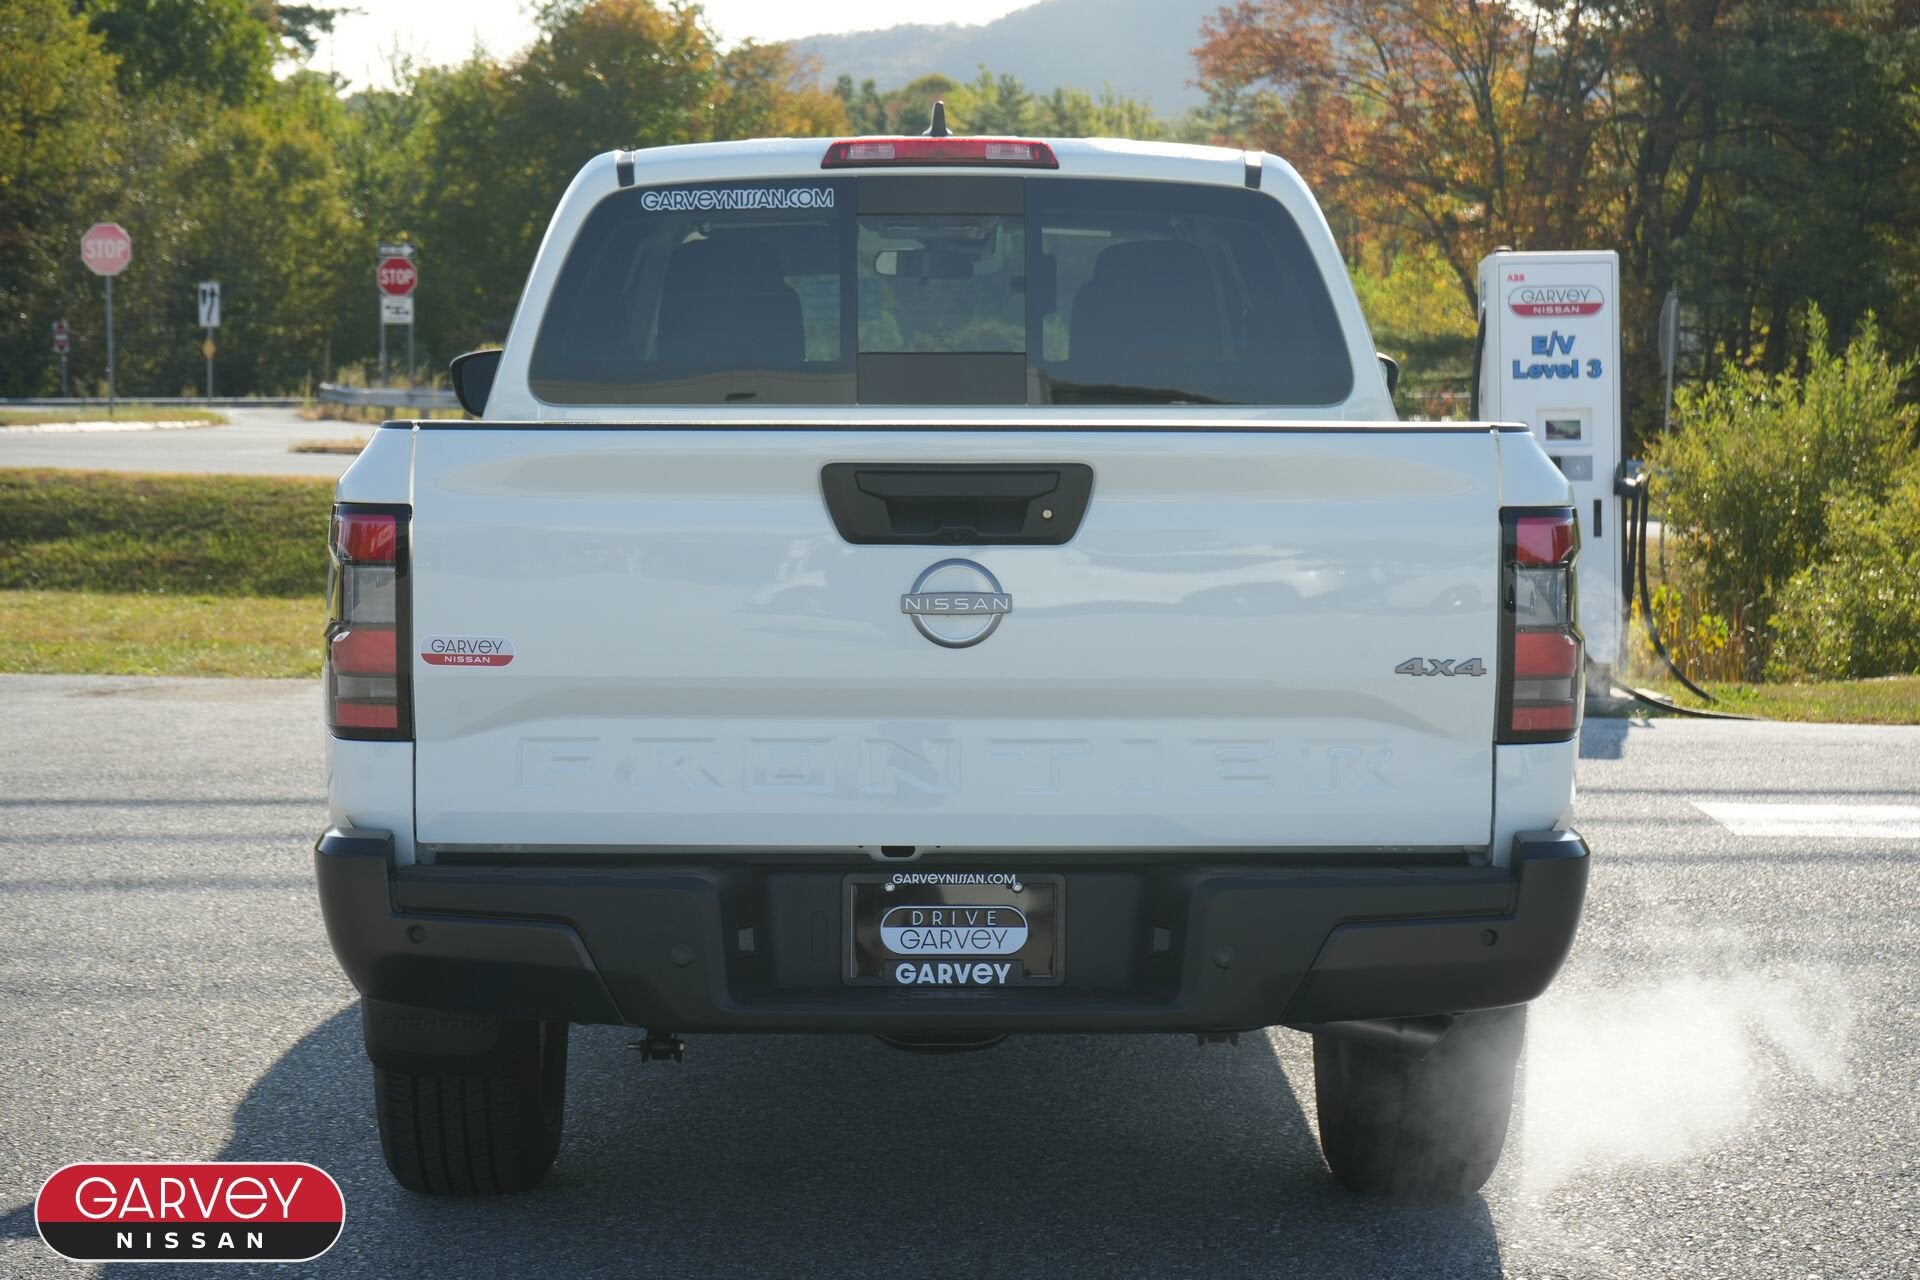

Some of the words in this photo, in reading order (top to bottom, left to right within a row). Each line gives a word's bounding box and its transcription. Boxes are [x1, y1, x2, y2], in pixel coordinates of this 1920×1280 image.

[86, 239, 127, 259] STOP
[380, 268, 415, 285] STOP
[1507, 274, 1525, 282] ABB
[1533, 305, 1580, 314] NISSAN
[1531, 330, 1575, 357] E/V
[1512, 359, 1579, 379] Level
[1586, 359, 1602, 379] 3
[904, 597, 1010, 613] NISSAN
[444, 655, 491, 664] NISSAN
[515, 736, 1396, 796] FRONTIER
[912, 910, 998, 926] DRIVE
